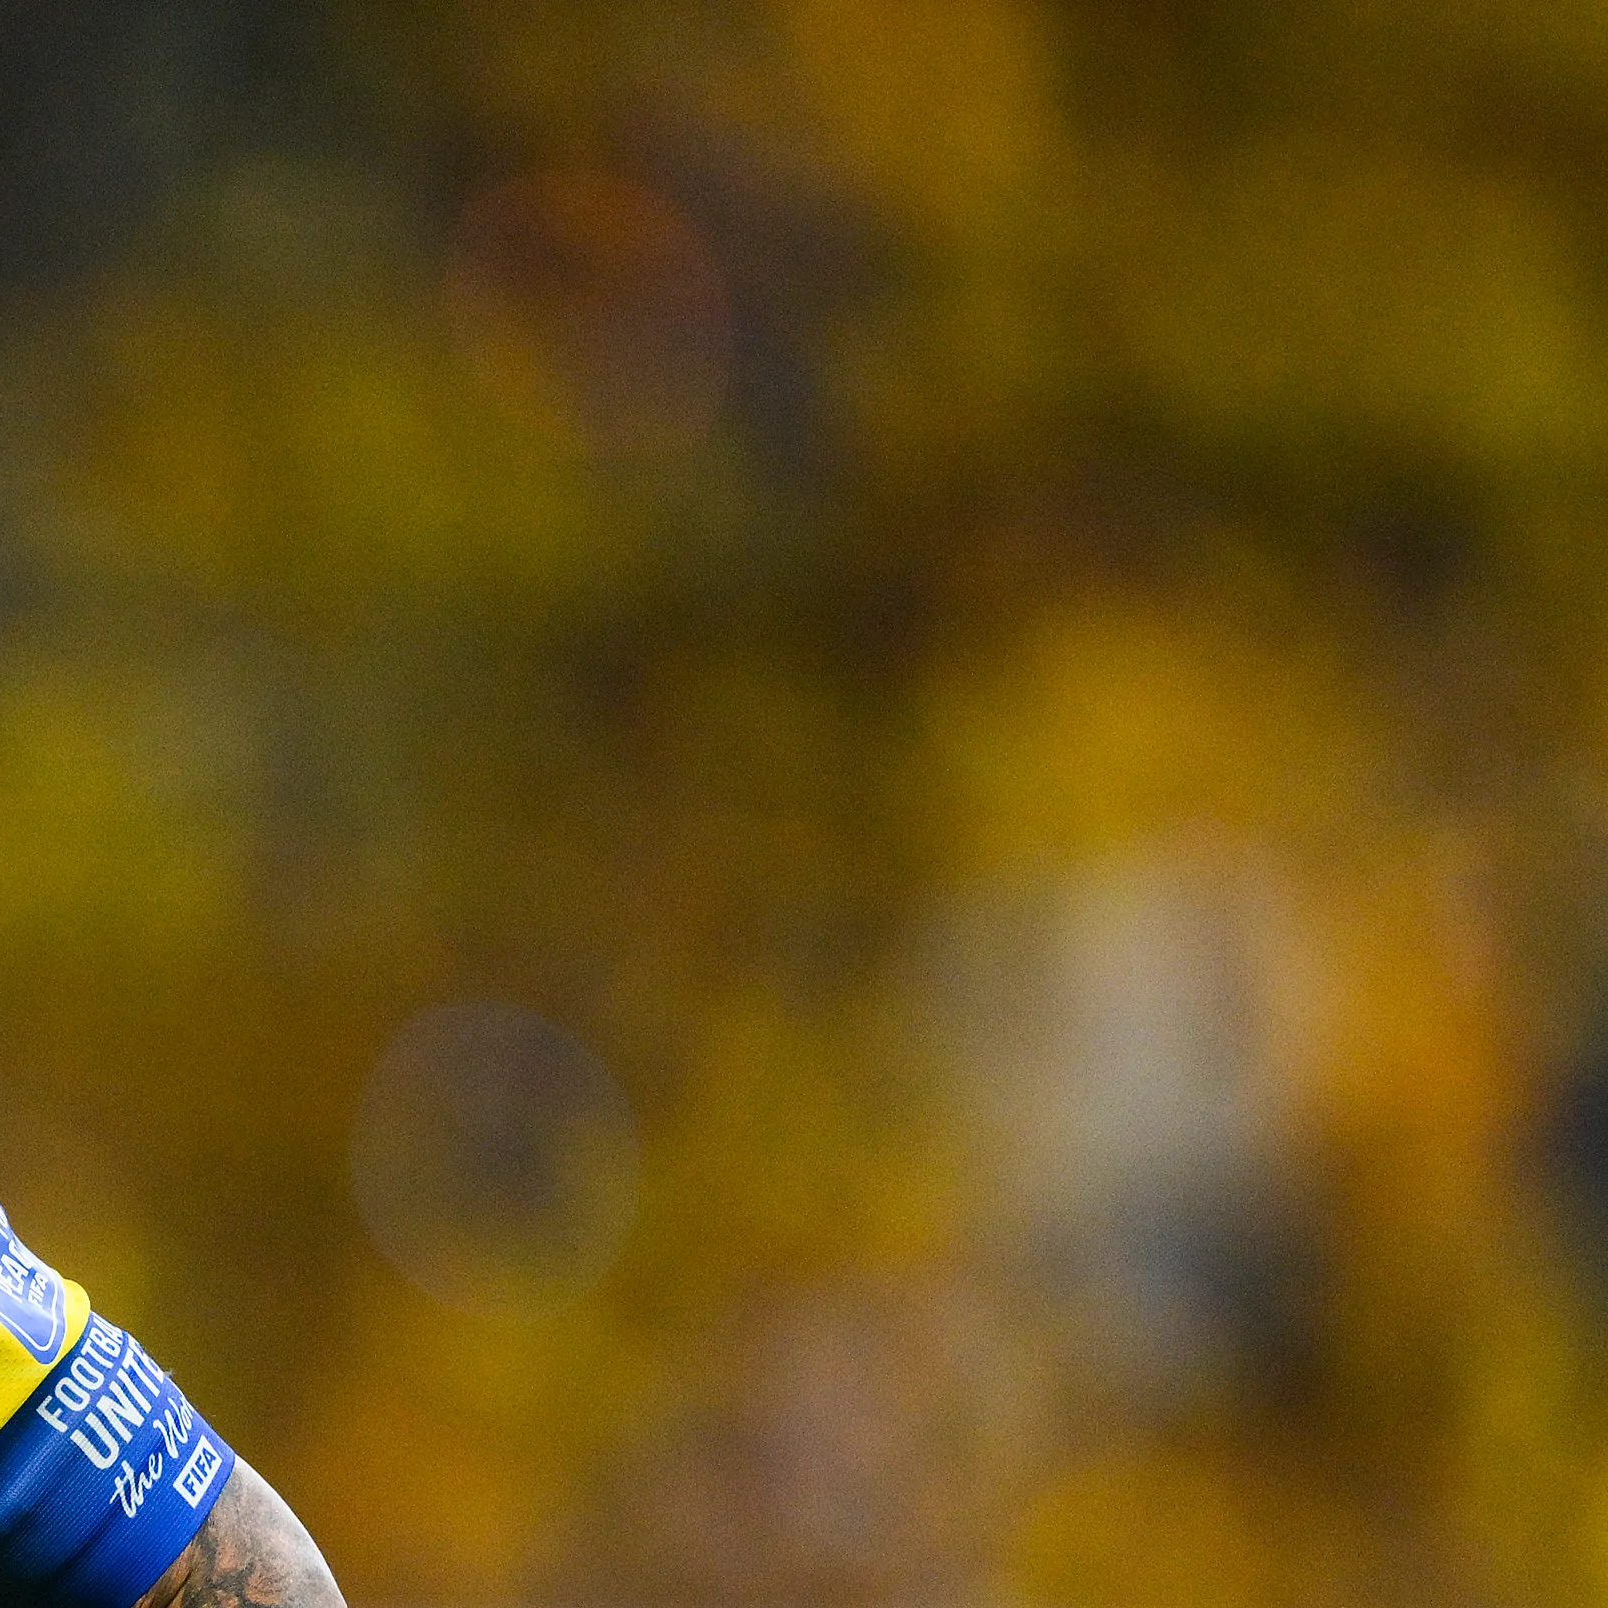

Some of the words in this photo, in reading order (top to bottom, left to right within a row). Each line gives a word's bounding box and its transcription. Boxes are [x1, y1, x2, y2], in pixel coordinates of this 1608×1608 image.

[28, 1272, 49, 1305] FIFA
[36, 1312, 124, 1433] FOOTBA
[70, 1334, 164, 1470] UNITE
[109, 1452, 163, 1518] the
[181, 1448, 217, 1497] FIFA
